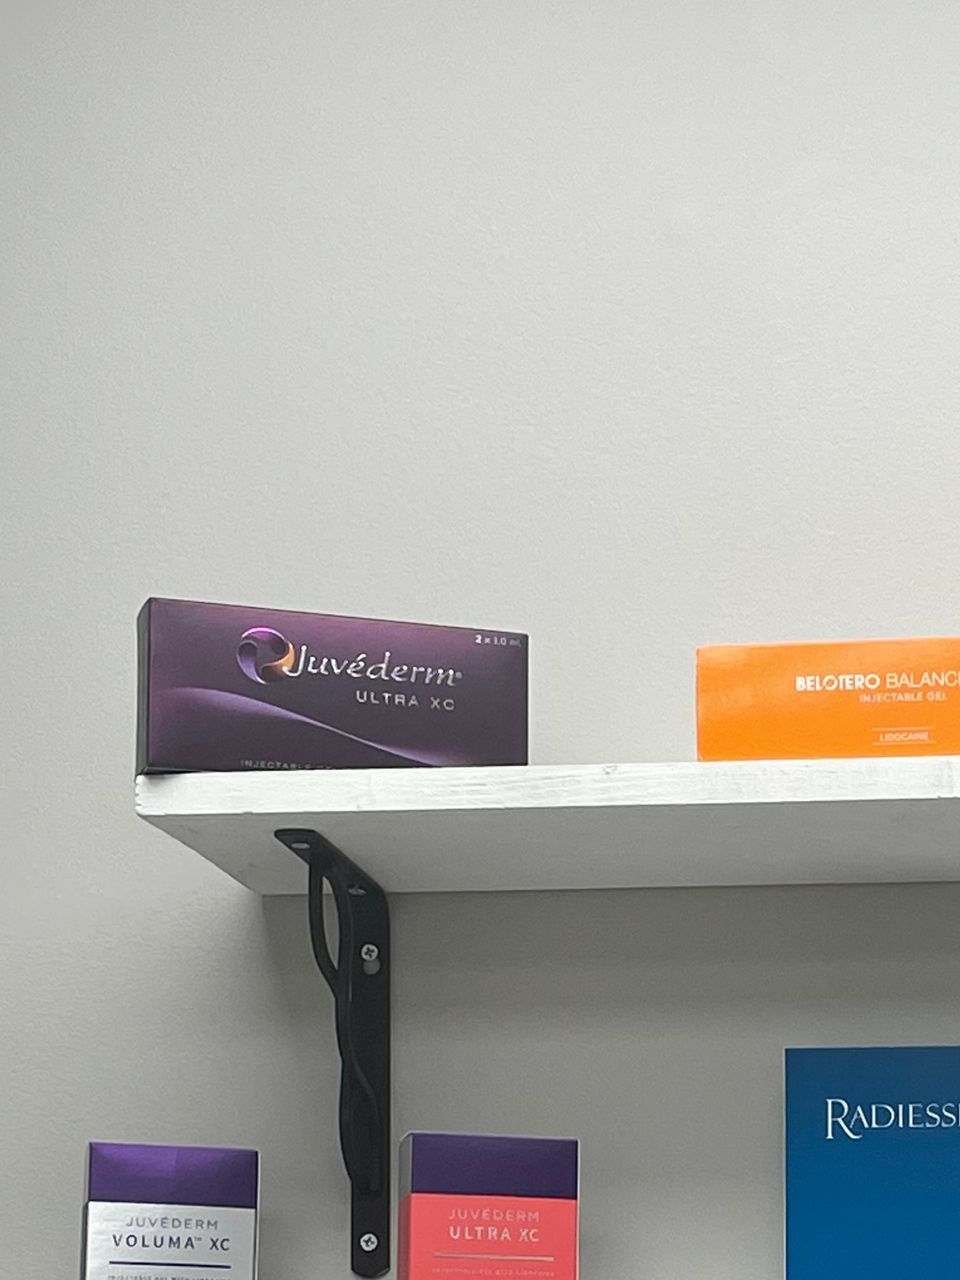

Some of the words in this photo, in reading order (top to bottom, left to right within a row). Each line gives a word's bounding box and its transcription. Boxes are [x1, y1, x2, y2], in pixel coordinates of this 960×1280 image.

[475, 633, 482, 645] 2
[282, 644, 456, 687] Juvéderm
[796, 674, 881, 692] BELOTERO
[356, 690, 419, 709] ULTRA
[430, 696, 456, 712] XC
[859, 692, 923, 703] INJECTABLE
[927, 691, 949, 701] GEL
[879, 732, 929, 742] LIDOCAINE
[126, 1216, 218, 1231] JUVÉDERM
[450, 1226, 512, 1242] ULTRA
[518, 1229, 540, 1242] XC
[209, 1238, 231, 1251] XC
